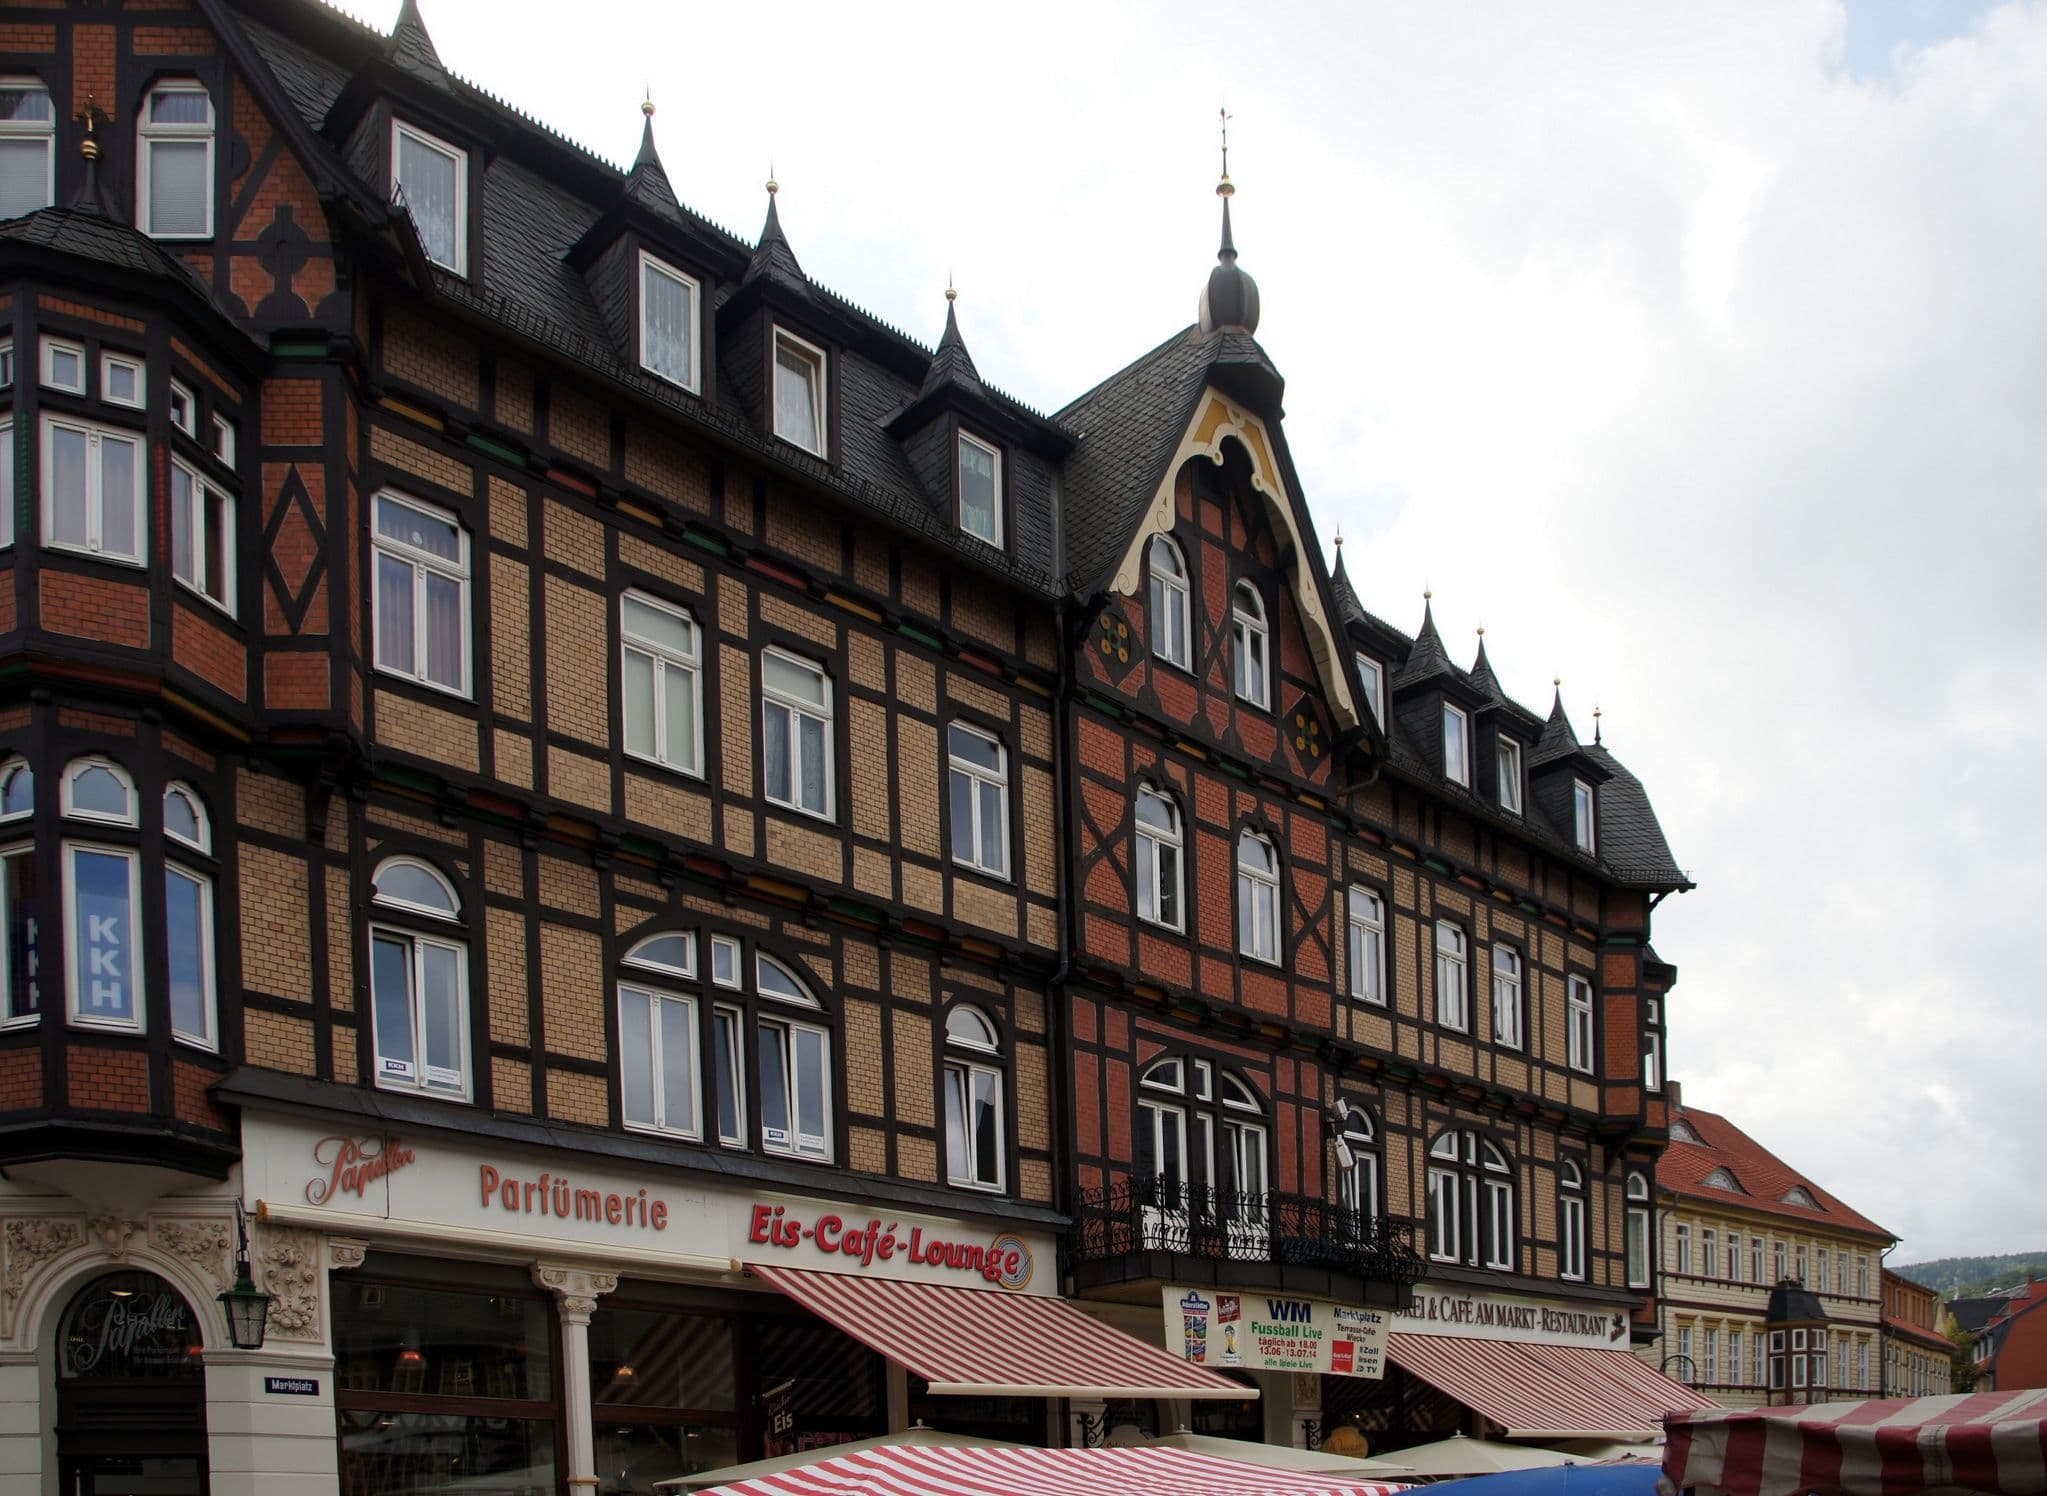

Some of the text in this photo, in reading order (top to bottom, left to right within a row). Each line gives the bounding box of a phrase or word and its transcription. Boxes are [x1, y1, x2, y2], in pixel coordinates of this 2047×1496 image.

[89, 915, 122, 1009] KKH
[388, 1062, 405, 1070] KKH
[480, 1164, 669, 1231] Parfümerie
[750, 1203, 1021, 1281] Eis-Café-Lounge
[1266, 1298, 1312, 1324] WM
[1333, 1307, 1382, 1325] Marktplatz
[1428, 1296, 1438, 1321] &
[1440, 1293, 1474, 1324] CAFÉ
[1477, 1303, 1495, 1326] AM
[1496, 1304, 1537, 1329] MARKT
[1542, 1308, 1608, 1337] RESTAURANT
[1251, 1321, 1323, 1340] Fussball Live
[1258, 1337, 1318, 1350] täglich ab 18.00
[1264, 1358, 1277, 1366] alle
[1299, 1361, 1313, 1369] Live
[1367, 1366, 1378, 1374] TV
[271, 1379, 314, 1393] Marktplatz
[774, 1410, 793, 1435] Eis
